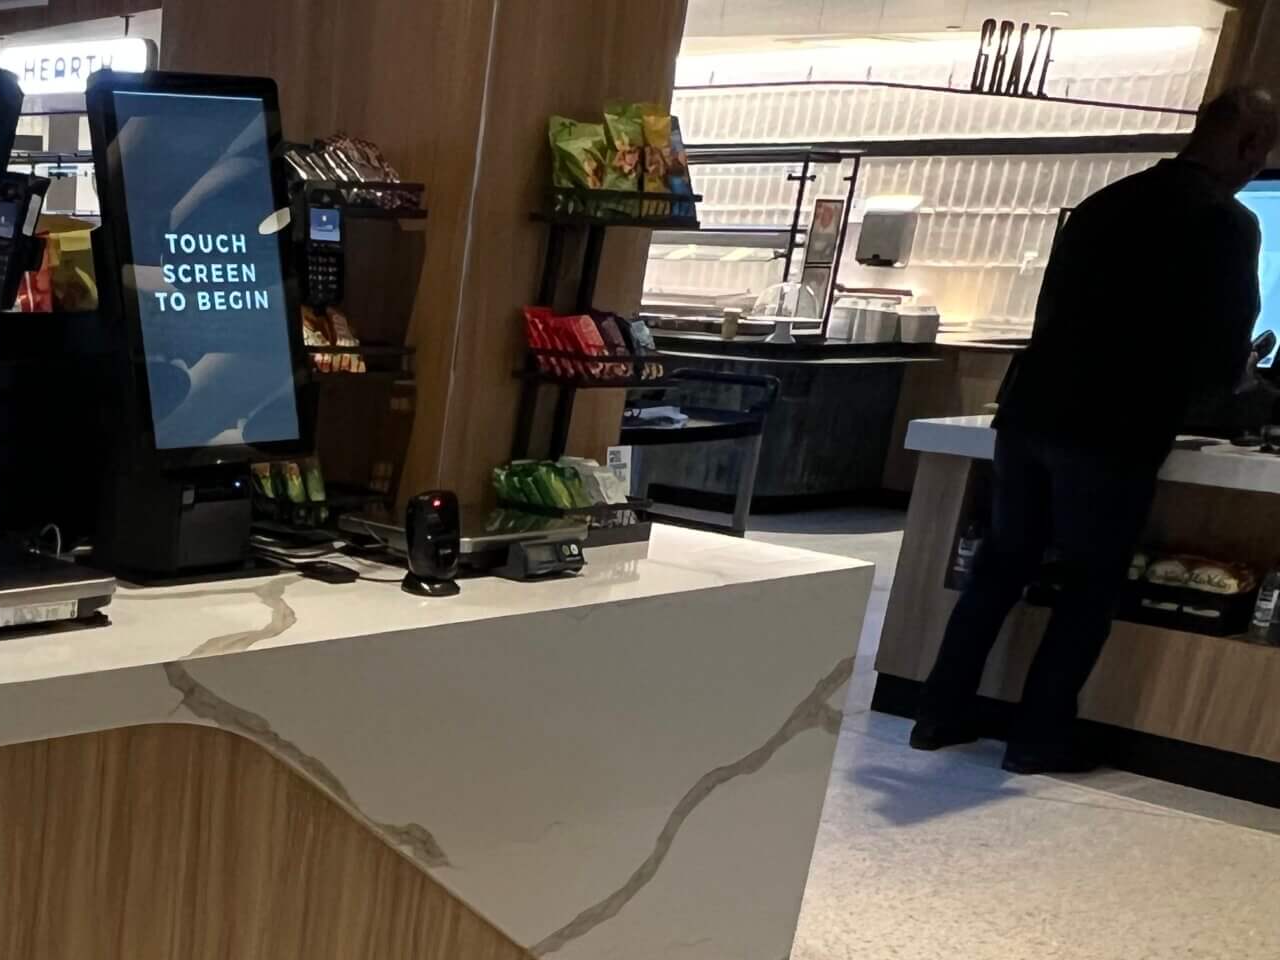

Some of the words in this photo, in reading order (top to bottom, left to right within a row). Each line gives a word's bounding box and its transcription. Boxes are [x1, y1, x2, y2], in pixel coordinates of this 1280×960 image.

[970, 18, 1062, 97] GRAZE
[164, 233, 246, 254] TOUCH
[163, 263, 256, 283] SCREEN
[155, 291, 186, 312] TO
[197, 290, 269, 311] BEGIN
